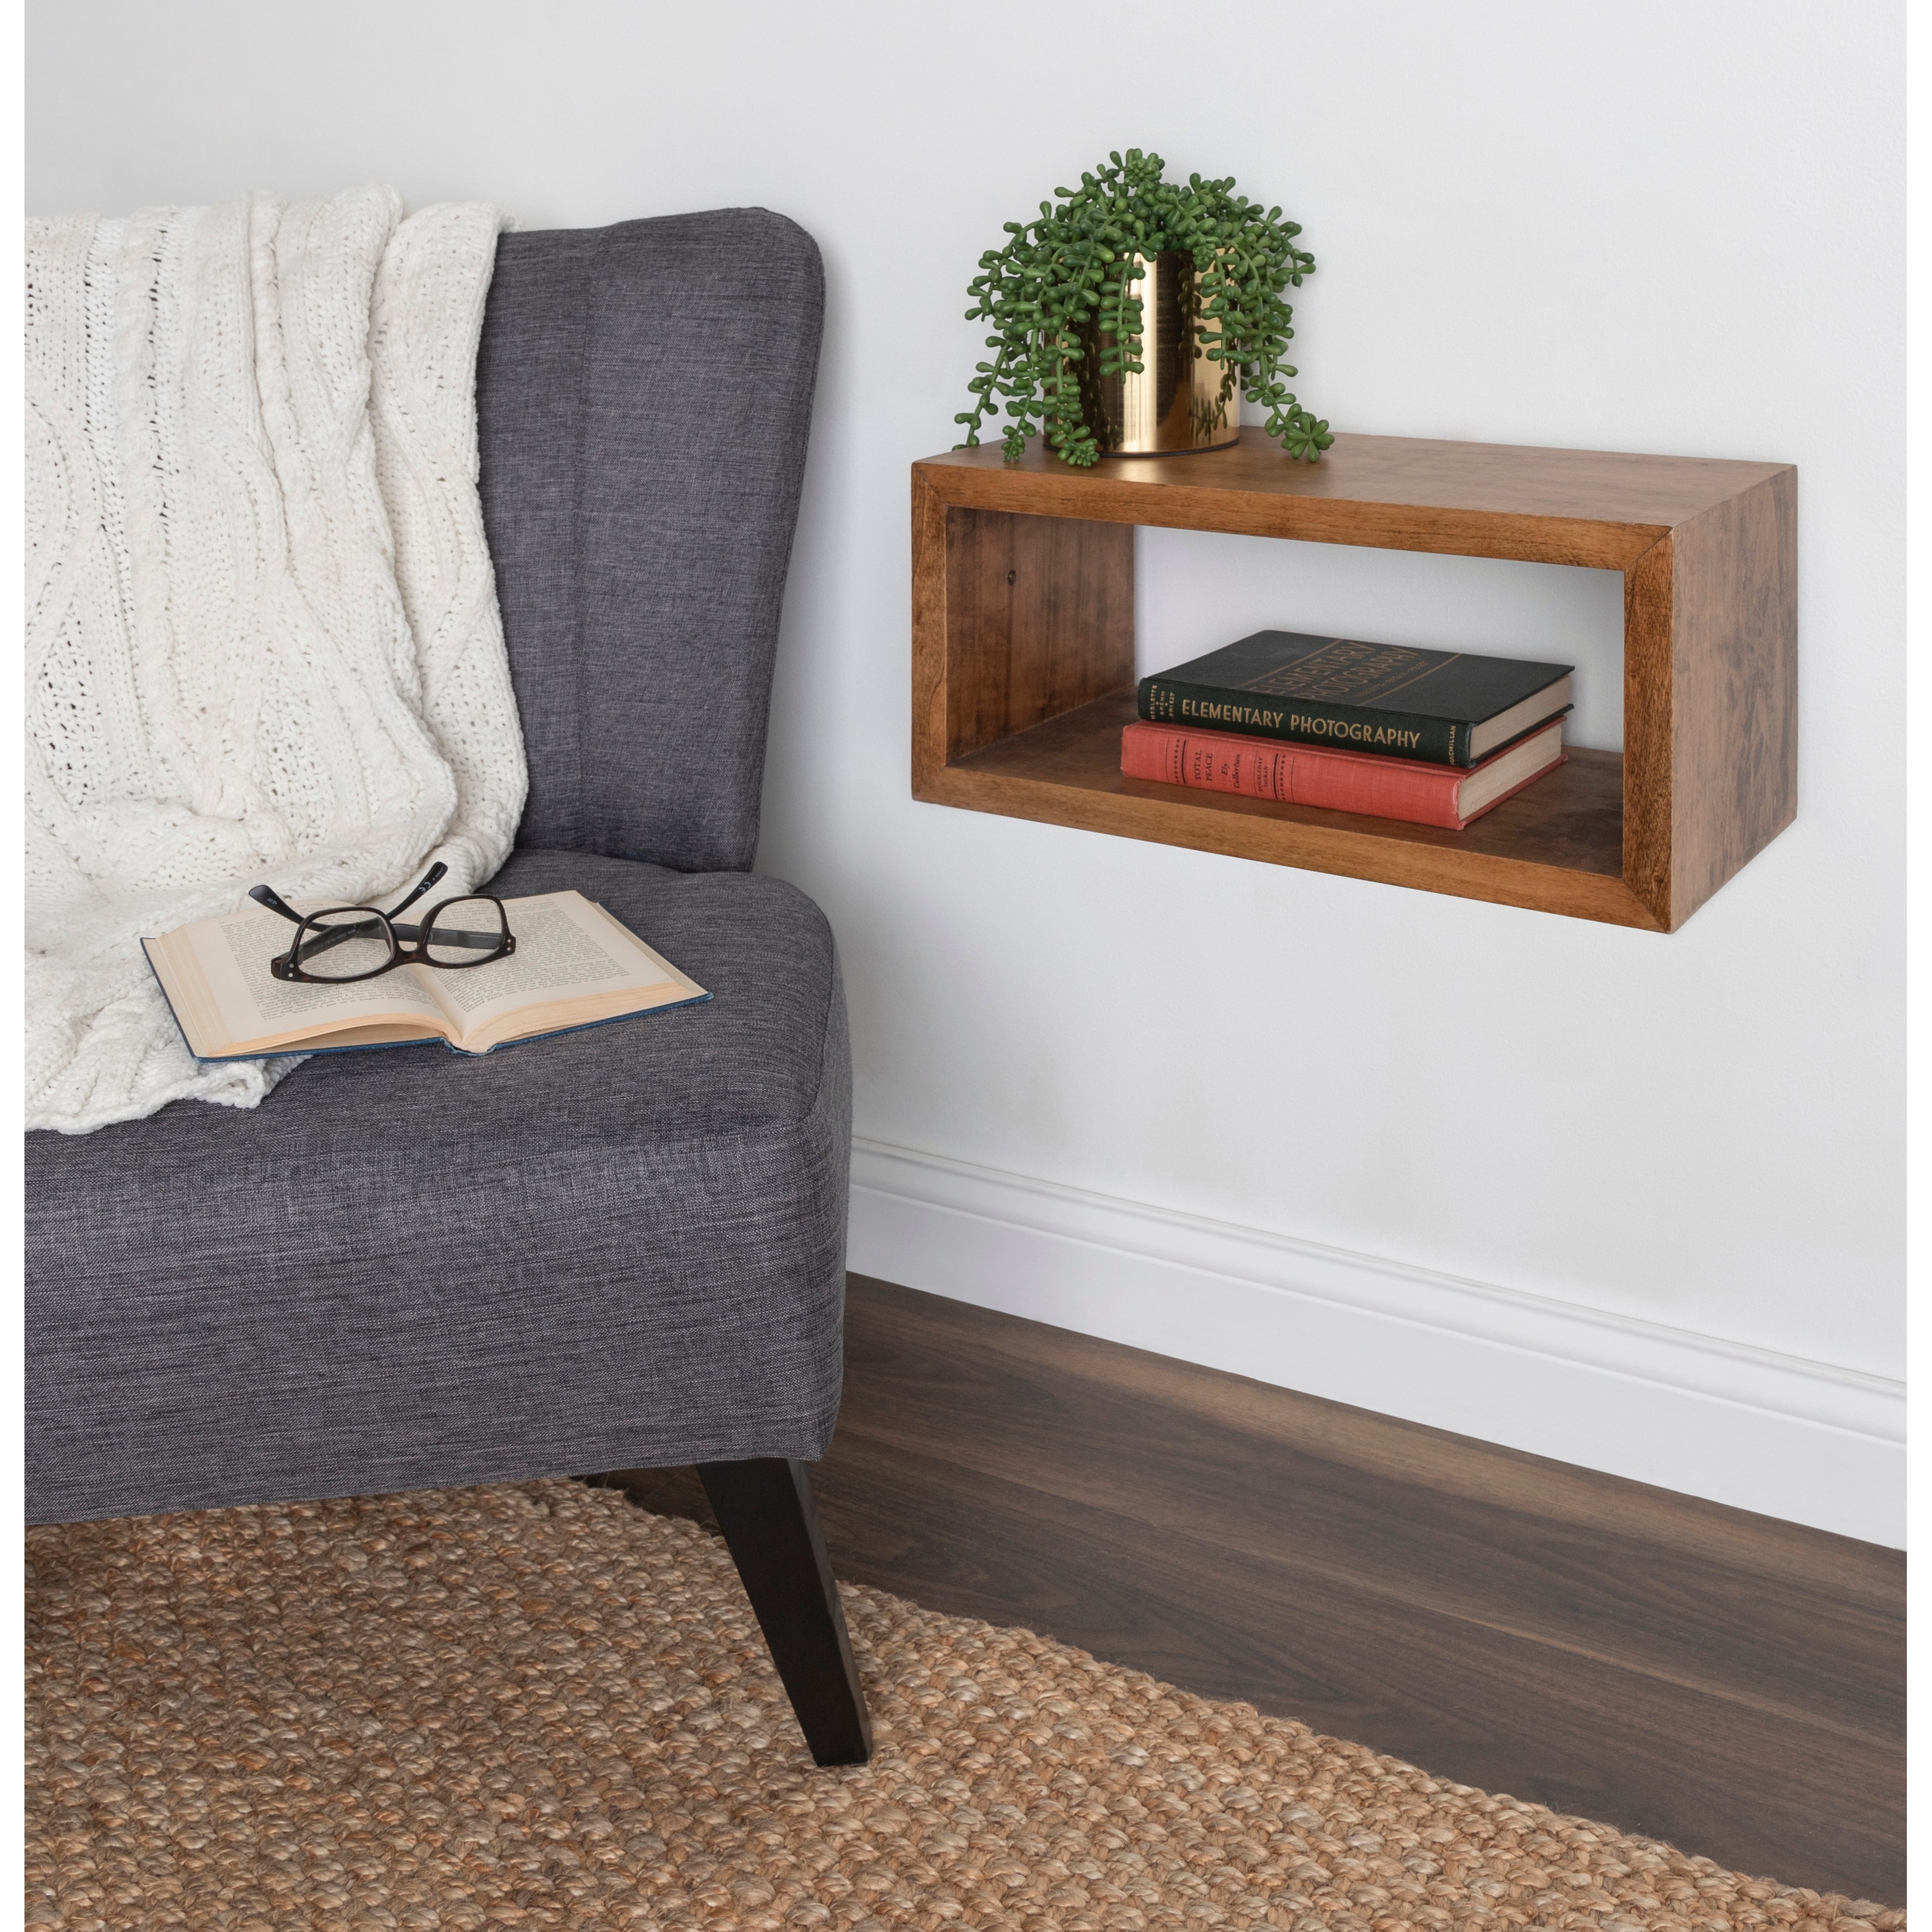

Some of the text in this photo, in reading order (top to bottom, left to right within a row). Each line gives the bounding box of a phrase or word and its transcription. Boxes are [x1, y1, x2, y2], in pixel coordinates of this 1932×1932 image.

[1182, 699, 1420, 748] ELEMENTARY PHOTOGRAPHY
[1221, 763, 1230, 775] Ely
